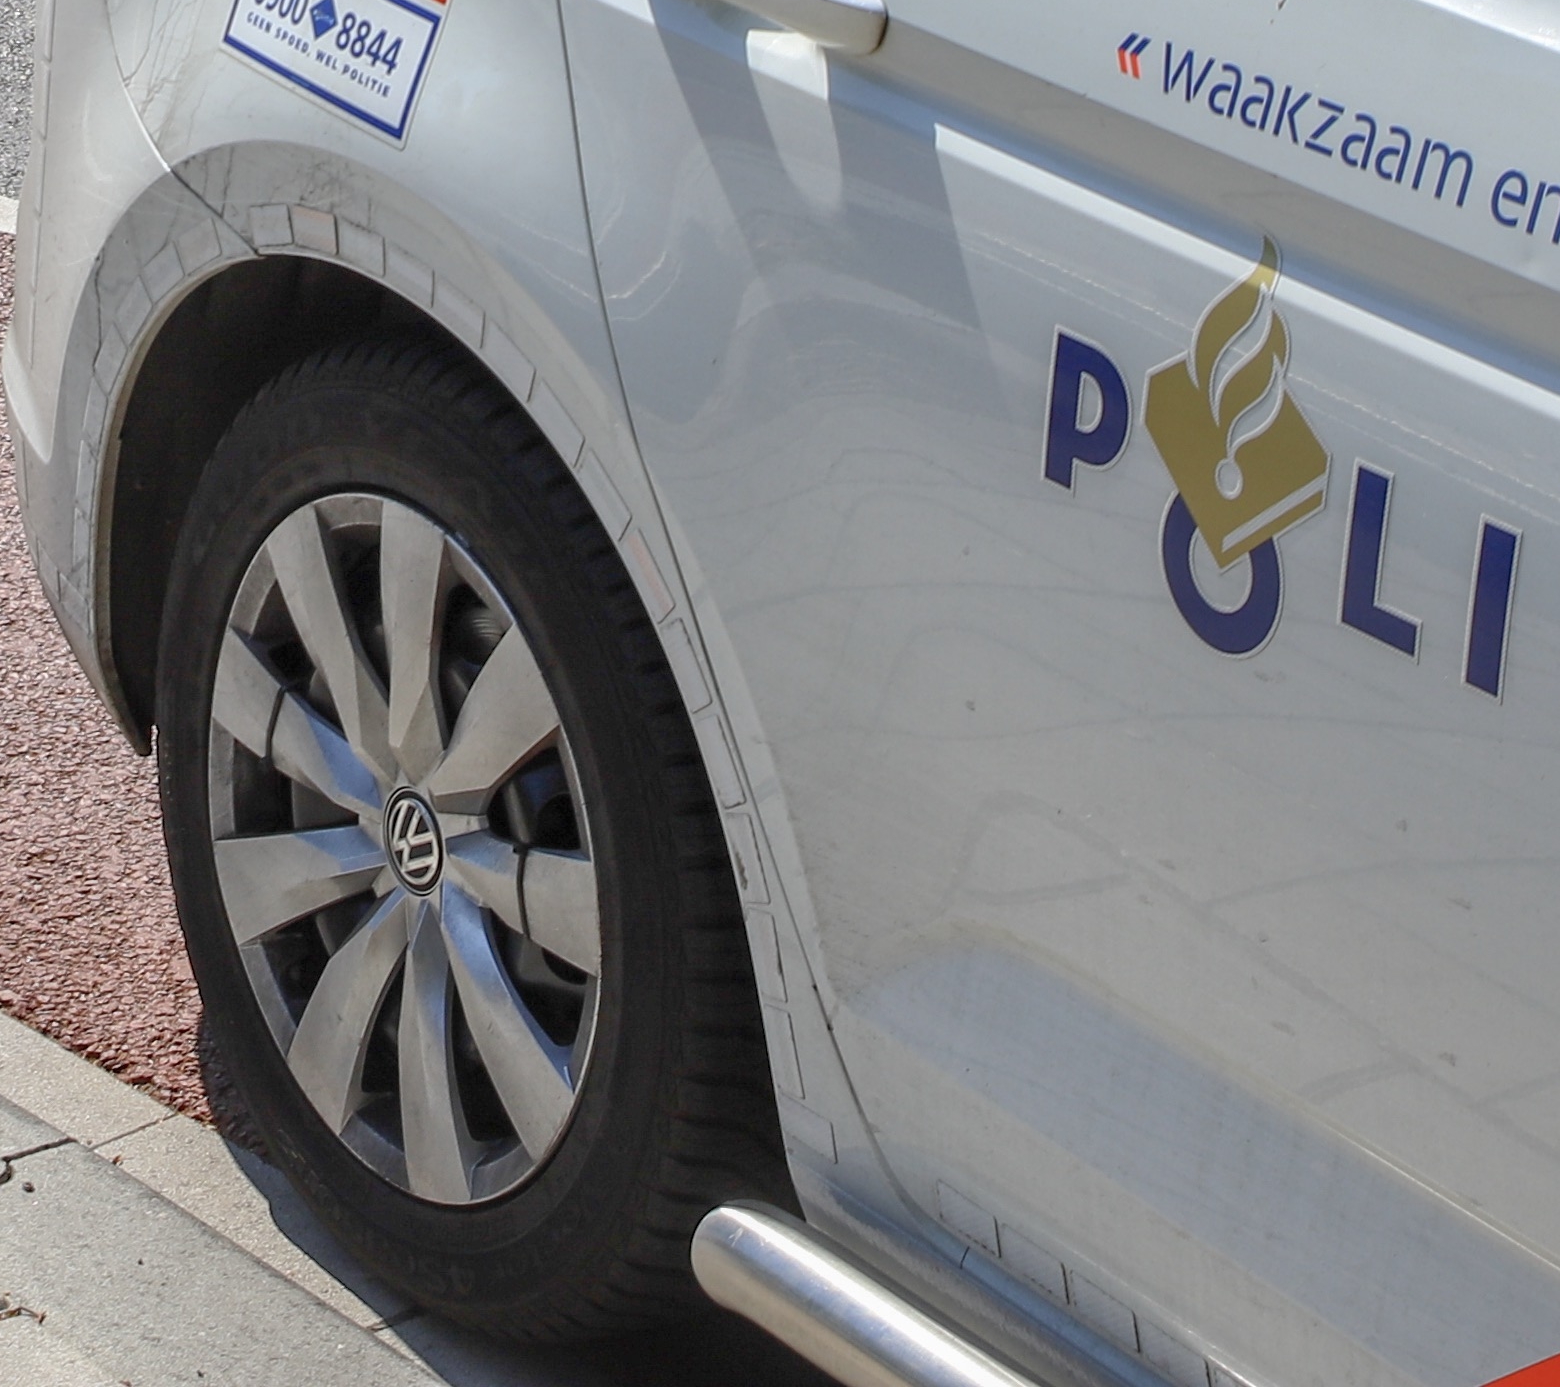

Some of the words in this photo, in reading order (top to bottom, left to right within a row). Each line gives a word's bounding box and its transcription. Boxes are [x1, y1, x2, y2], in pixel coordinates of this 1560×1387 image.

[246, 11, 273, 34] GEEN
[314, 50, 338, 71] WEL
[341, 64, 391, 98] POLITIE
[335, 12, 403, 76] 8844
[1163, 39, 1474, 207] waakzaam
